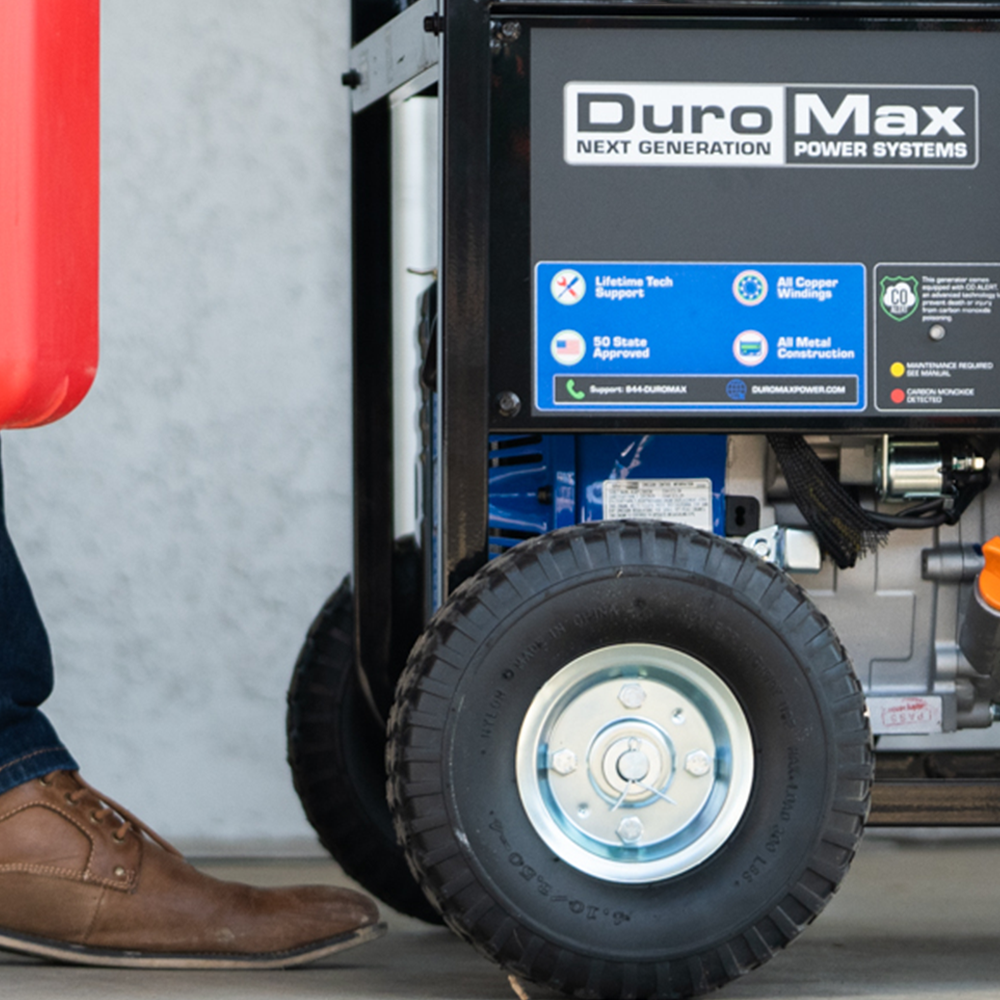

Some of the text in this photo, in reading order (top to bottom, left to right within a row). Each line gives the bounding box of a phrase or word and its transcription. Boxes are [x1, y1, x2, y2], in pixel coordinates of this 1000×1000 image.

[577, 140, 771, 156] NEXT GENERATION
[794, 141, 968, 159] POWER SYSTEMS
[595, 275, 673, 288] Lifetime Tech
[777, 277, 838, 291] All Copper
[595, 287, 645, 301] Support
[777, 288, 832, 301] Windings
[890, 288, 908, 306] CO
[593, 336, 648, 348] 50 State
[777, 337, 832, 349] All Metal
[593, 347, 650, 360] Approved
[777, 348, 855, 360] Construction
[906, 361, 994, 370] MAINTENANCE REQUIRED
[906, 370, 952, 378] SEE MANUAL
[751, 385, 846, 395] DUROMAXPOWER.COM
[906, 388, 975, 396] CARBON MONOXIDE
[906, 396, 943, 404] DETECTED
